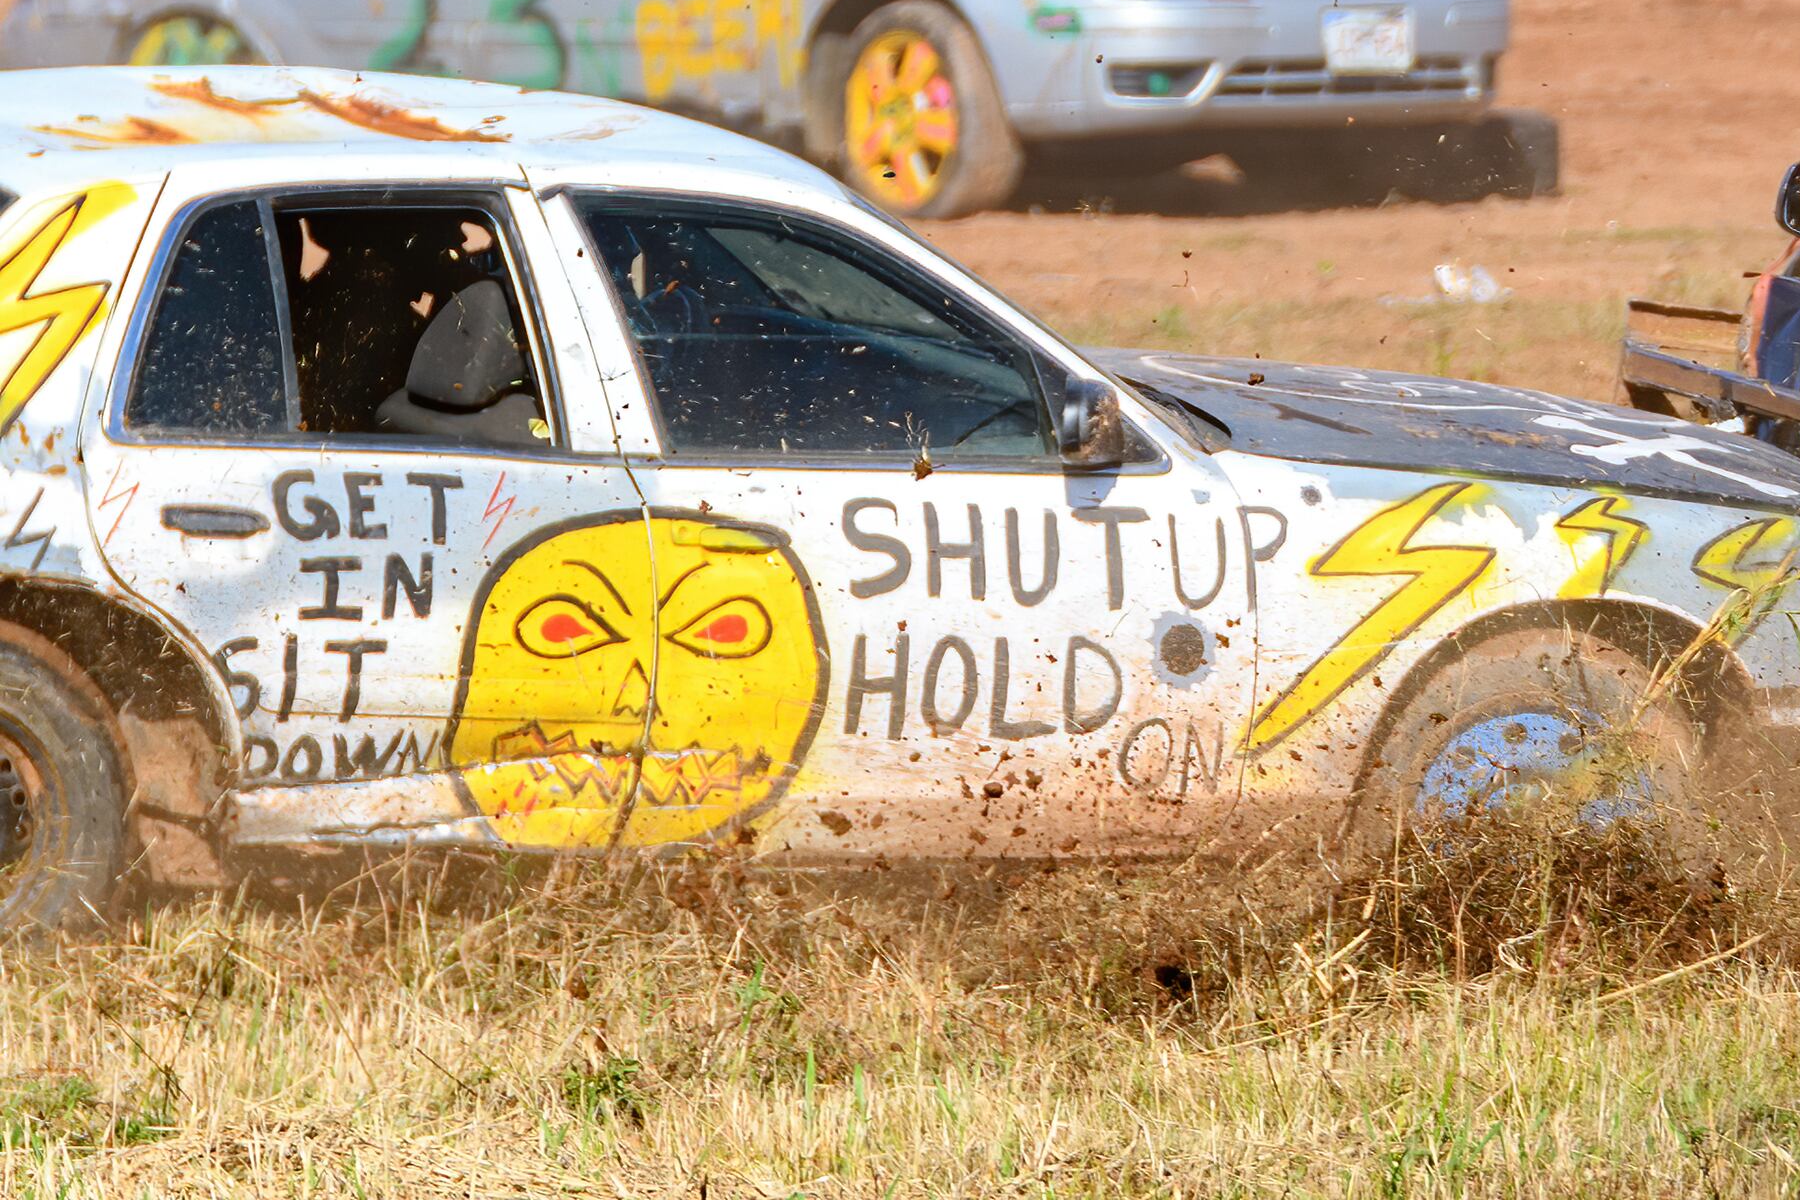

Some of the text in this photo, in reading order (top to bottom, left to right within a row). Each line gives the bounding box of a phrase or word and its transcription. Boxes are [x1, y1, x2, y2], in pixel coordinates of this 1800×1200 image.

[271, 468, 464, 545] GET
[297, 551, 434, 621] IN
[213, 633, 389, 723] SIT
[843, 633, 1123, 740] HOLD
[240, 728, 453, 779] DOWN
[1117, 717, 1223, 795] ON
